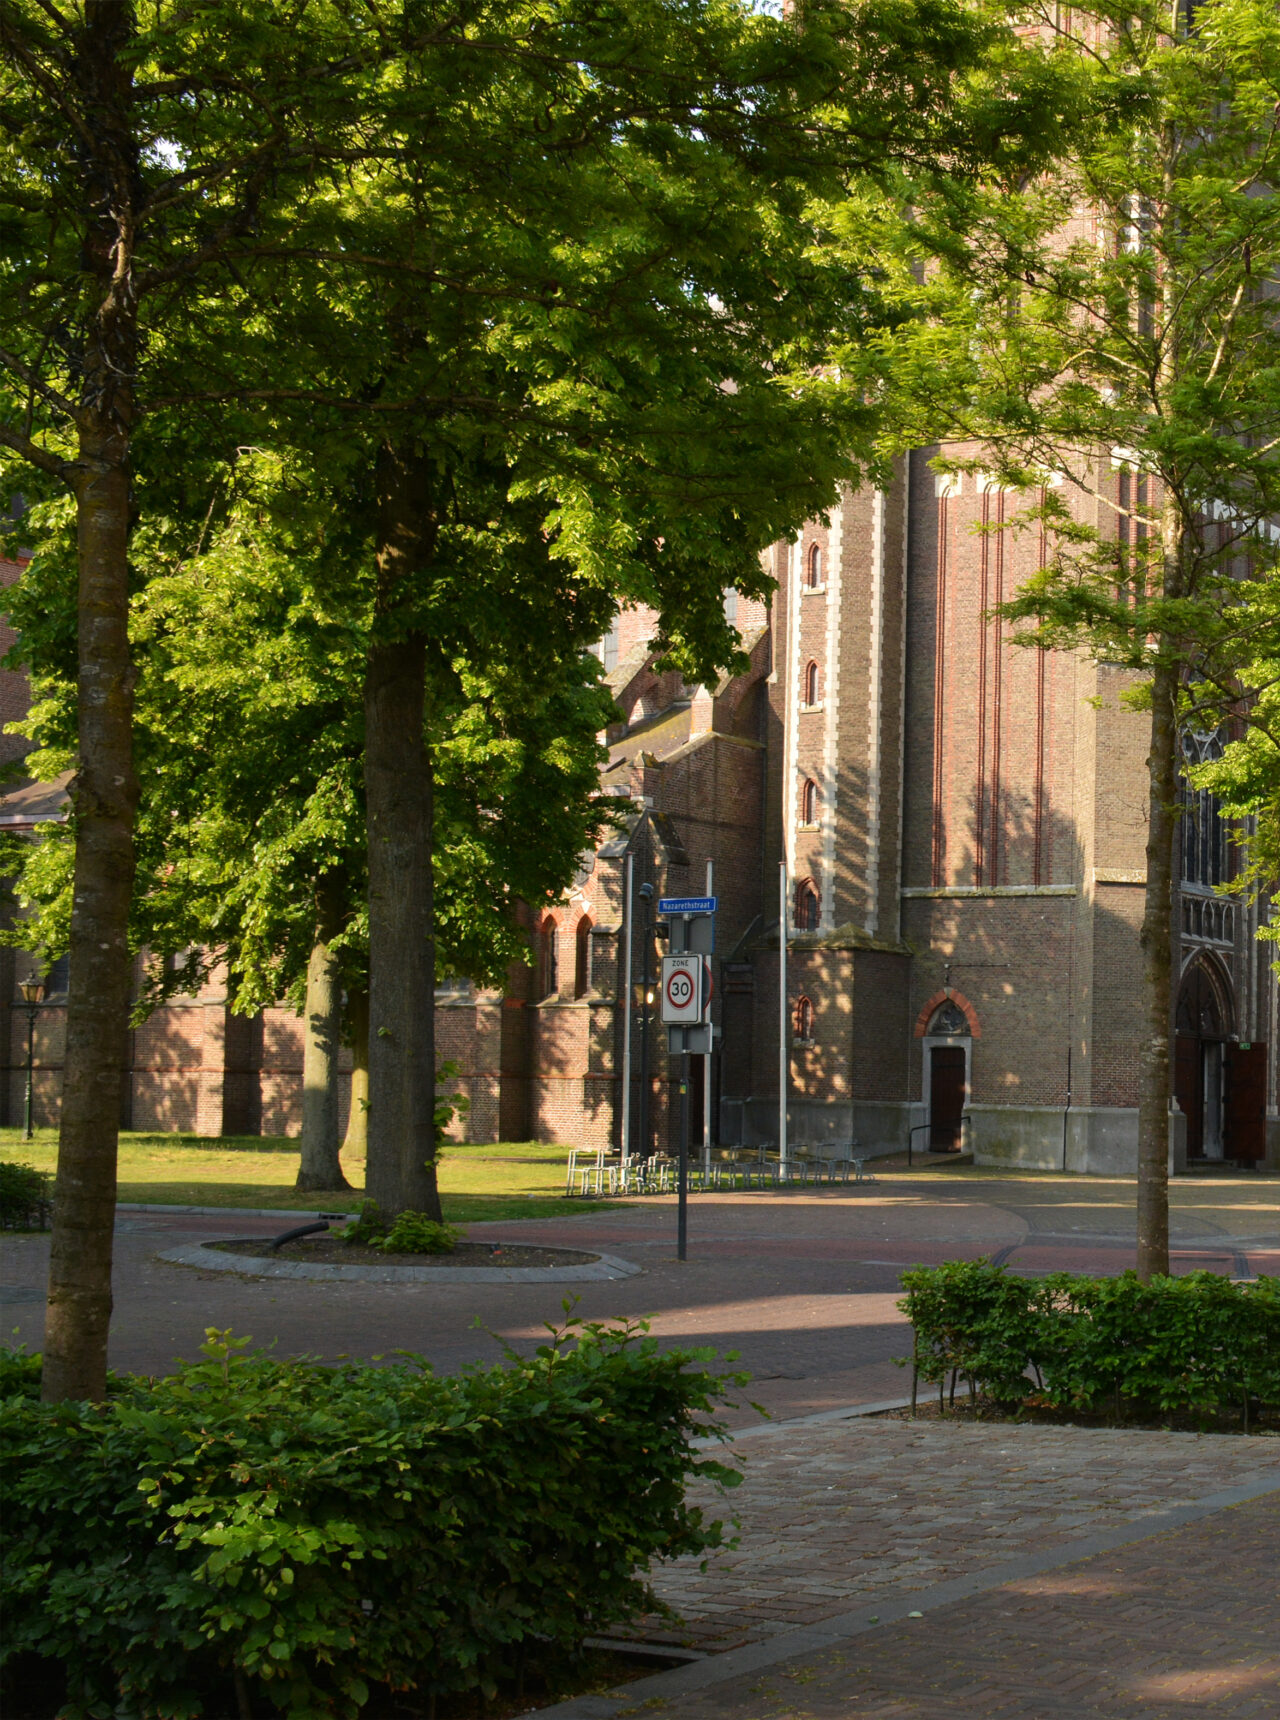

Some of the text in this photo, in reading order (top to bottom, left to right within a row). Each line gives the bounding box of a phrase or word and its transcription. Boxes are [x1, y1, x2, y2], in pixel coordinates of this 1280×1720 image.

[663, 902, 710, 910] Nazarethstraat
[672, 959, 689, 967] ZONE
[671, 982, 689, 997] 30
